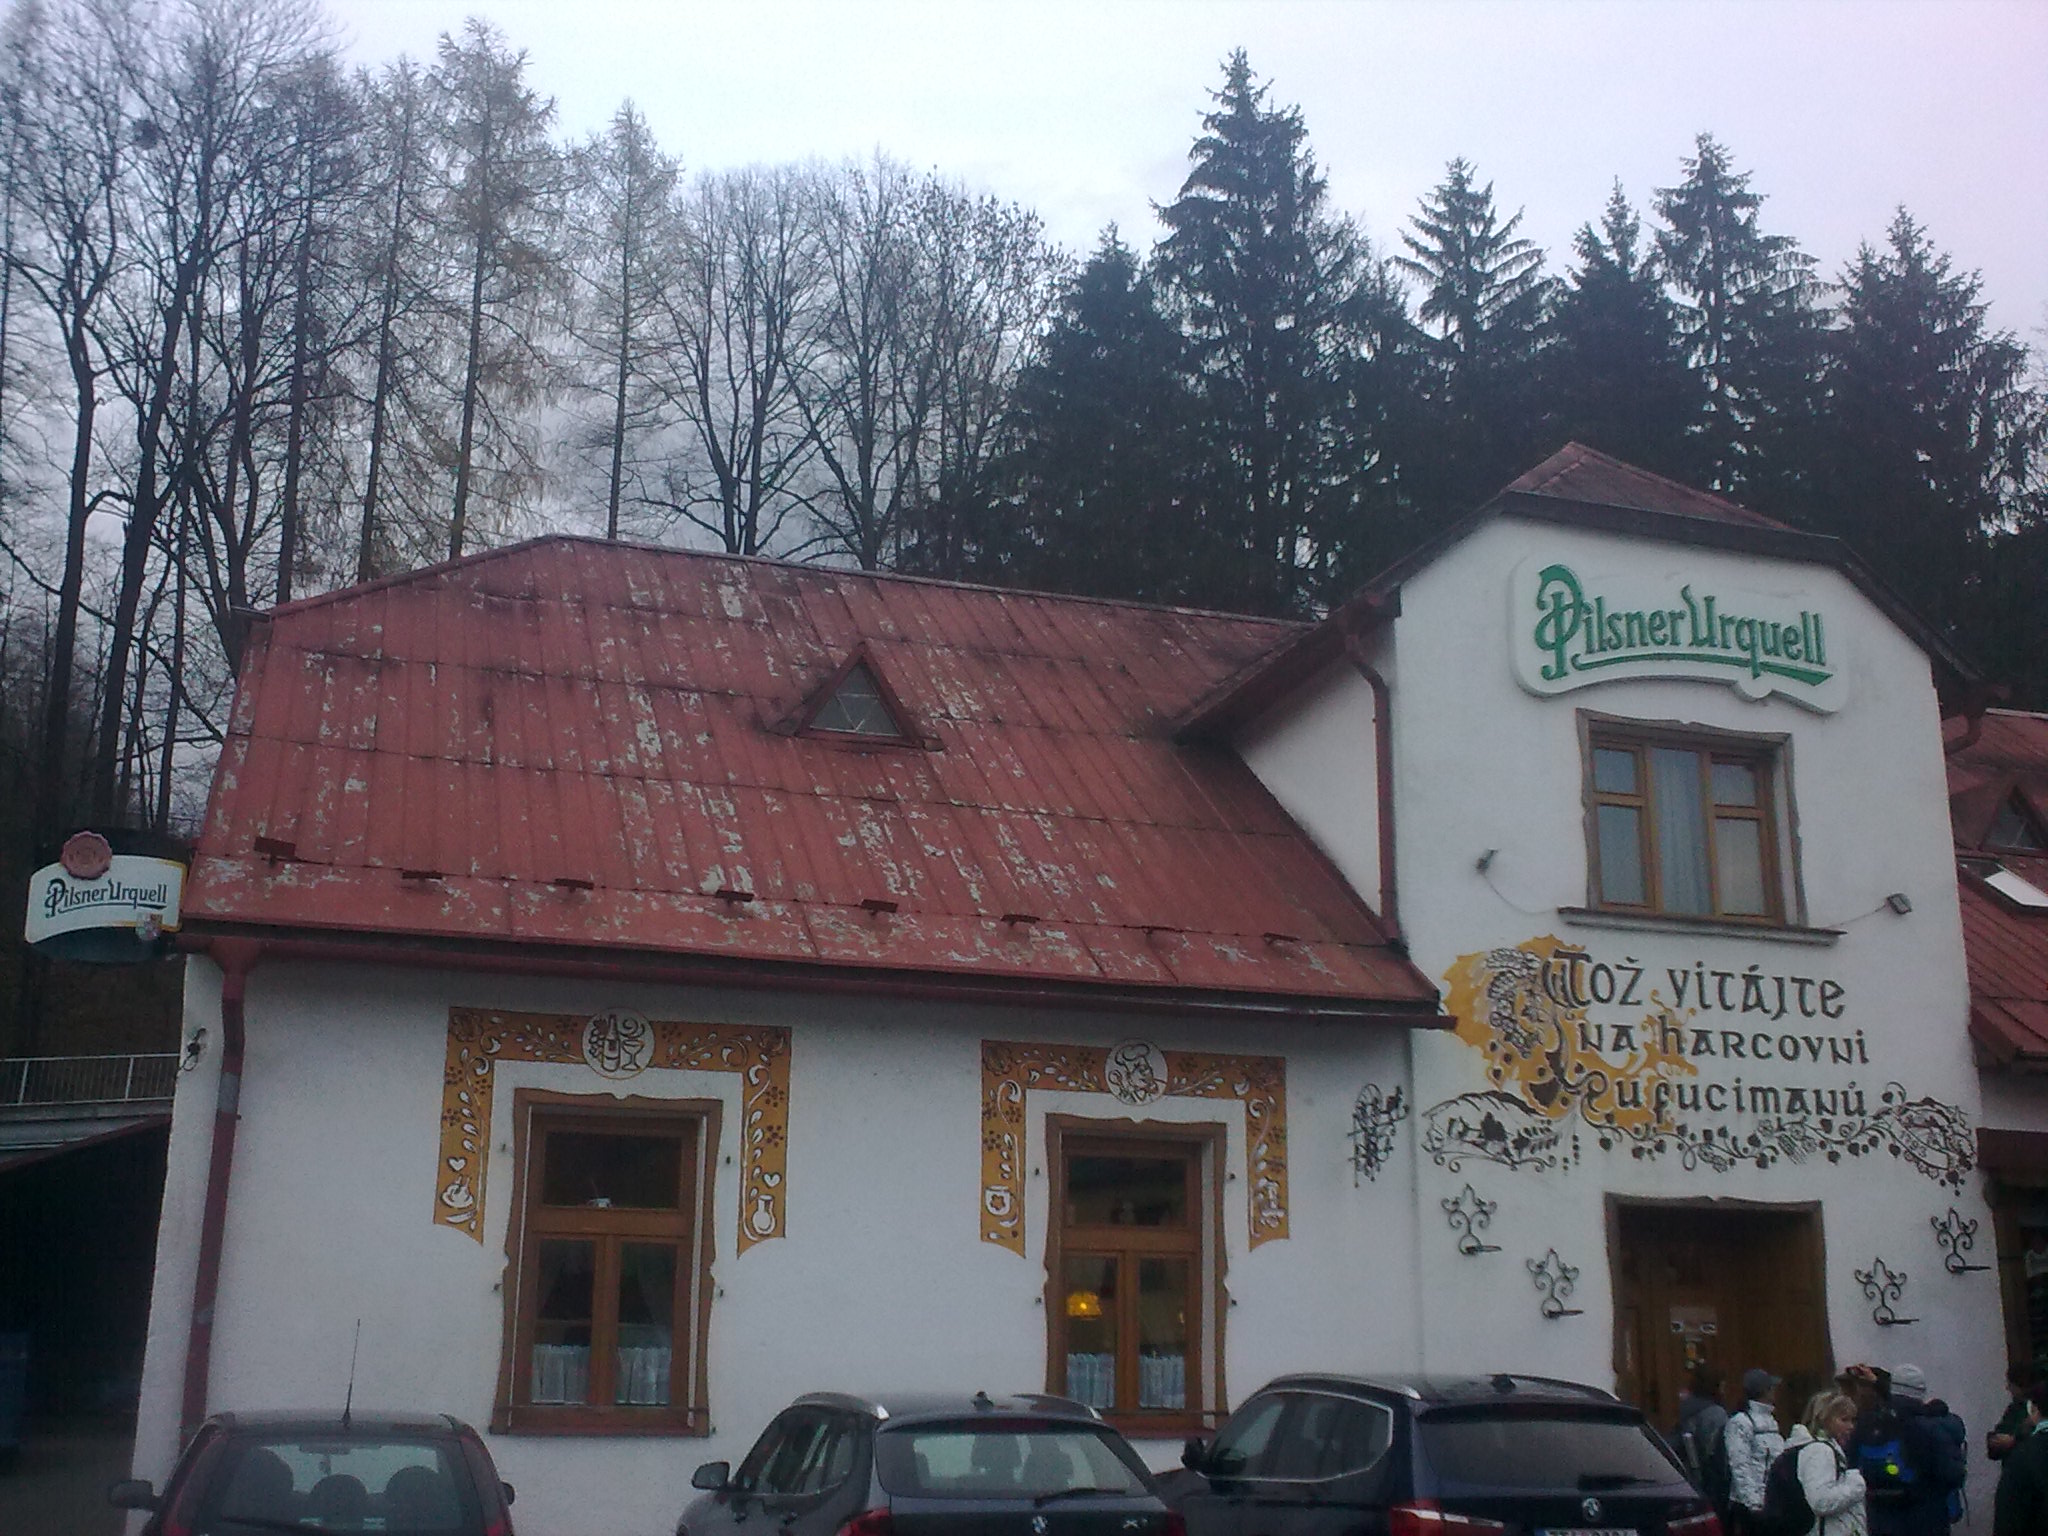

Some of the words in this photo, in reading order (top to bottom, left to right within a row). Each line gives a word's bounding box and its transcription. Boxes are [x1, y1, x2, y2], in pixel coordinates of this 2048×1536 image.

[1534, 563, 1687, 681] Pilsner
[1680, 584, 1827, 680] Urquell
[44, 878, 108, 919] Pilsner
[107, 878, 168, 909] Urquell
